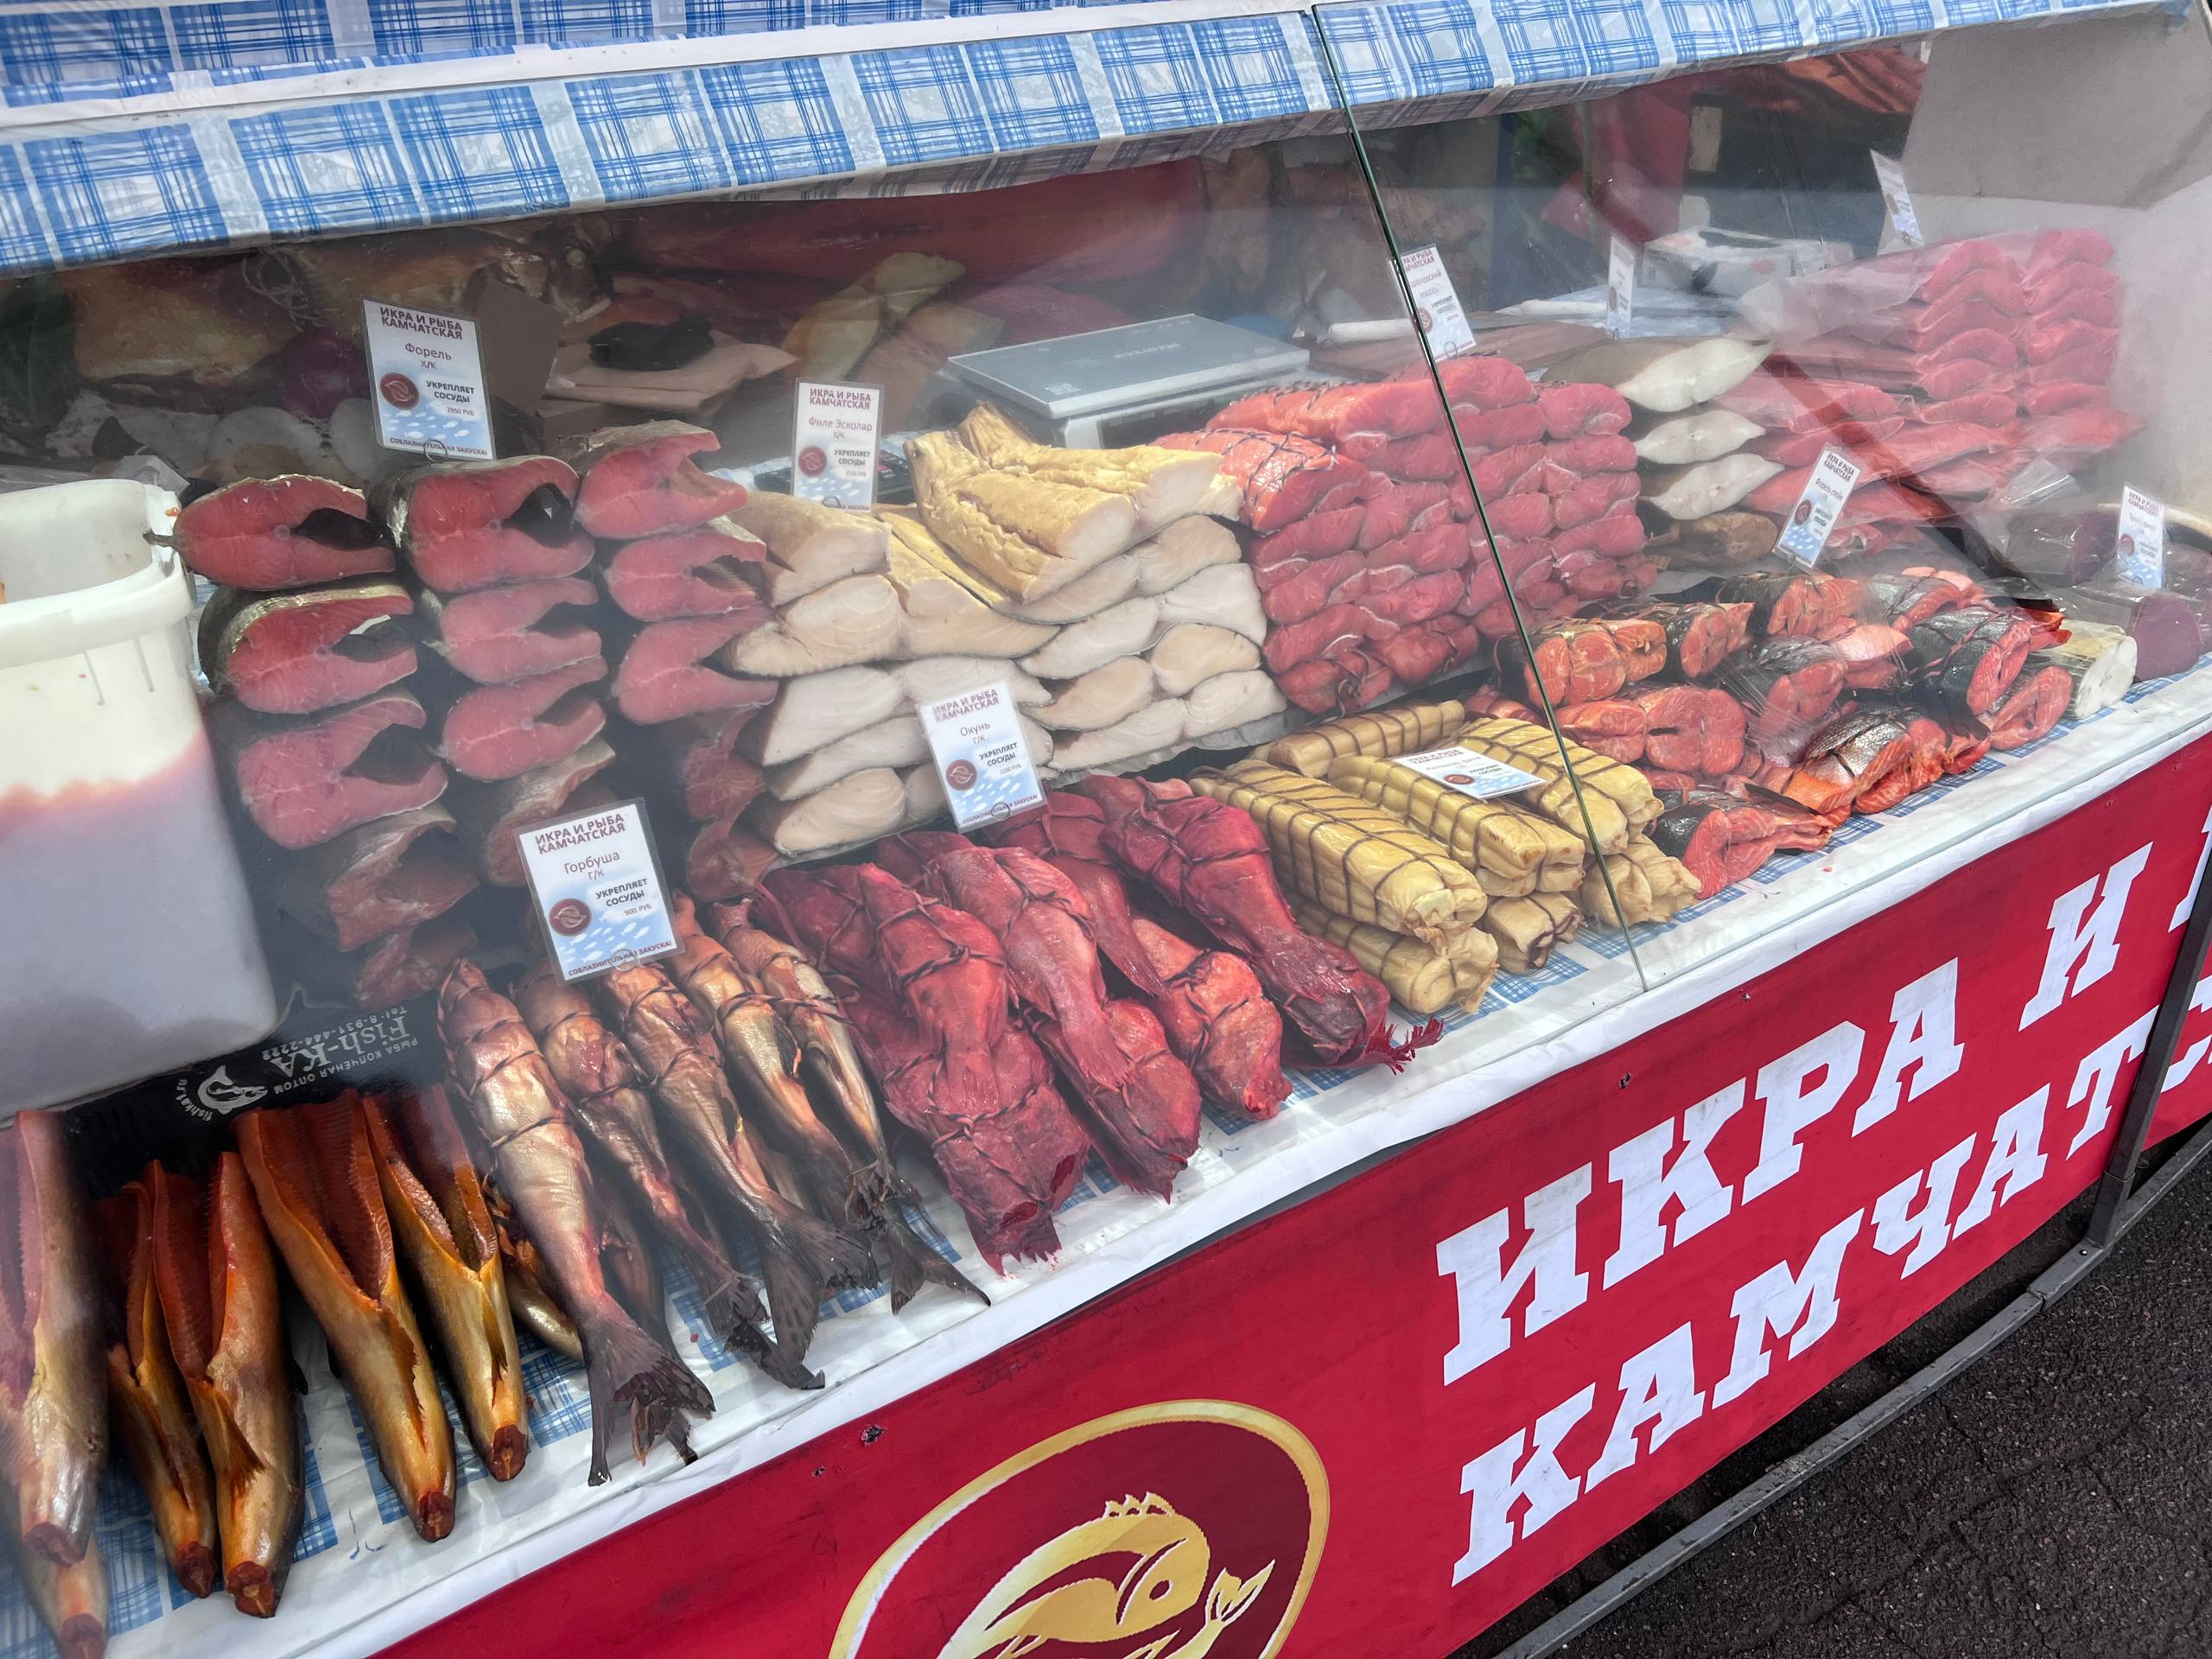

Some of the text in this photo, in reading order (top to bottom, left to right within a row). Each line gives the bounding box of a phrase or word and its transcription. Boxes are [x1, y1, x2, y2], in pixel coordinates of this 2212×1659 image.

[380, 307, 462, 332] ИКРА И РЫБА
[382, 316, 462, 340] КАМЧАТСКАЯ
[404, 343, 452, 360] Форель
[425, 380, 474, 394] УКРЕПЛЯЕТ
[810, 388, 835, 398] ИКРА
[846, 392, 871, 403] РЫБА
[434, 391, 470, 404] СОСУДЫ
[810, 397, 870, 410] КАМЧАТСКАЯ
[809, 416, 872, 432] Филе Эсколар
[834, 448, 871, 458] УКРЕПЛЯЕТ
[838, 458, 865, 467] СОСУДЫ
[932, 689, 998, 715] ИКРА И РЫБА
[936, 696, 1000, 722] КАМЧАТСКАЯ
[960, 722, 990, 737] Окунь
[979, 742, 1018, 760] УКРЕПЛЯЕТ
[987, 753, 1016, 767] СОСУДЫ
[535, 813, 624, 845] ИКРА И РЫБА
[538, 823, 626, 855] КАМЧАТСКАЯ
[564, 851, 620, 874] Горбуша
[595, 878, 648, 899] УКРЕПЛЯЕТ
[606, 890, 645, 907] СОСУДЫ
[624, 904, 652, 916] 900 РУБ
[639, 941, 672, 955] ЗАКУСКА!
[386, 1038, 418, 1055] РЫБА
[274, 1073, 316, 1094] ОПТОМ
[1436, 957, 1964, 1385] ИКРА
[2018, 841, 2154, 1032] И
[1452, 974, 2212, 1587] КАМЧАТ
